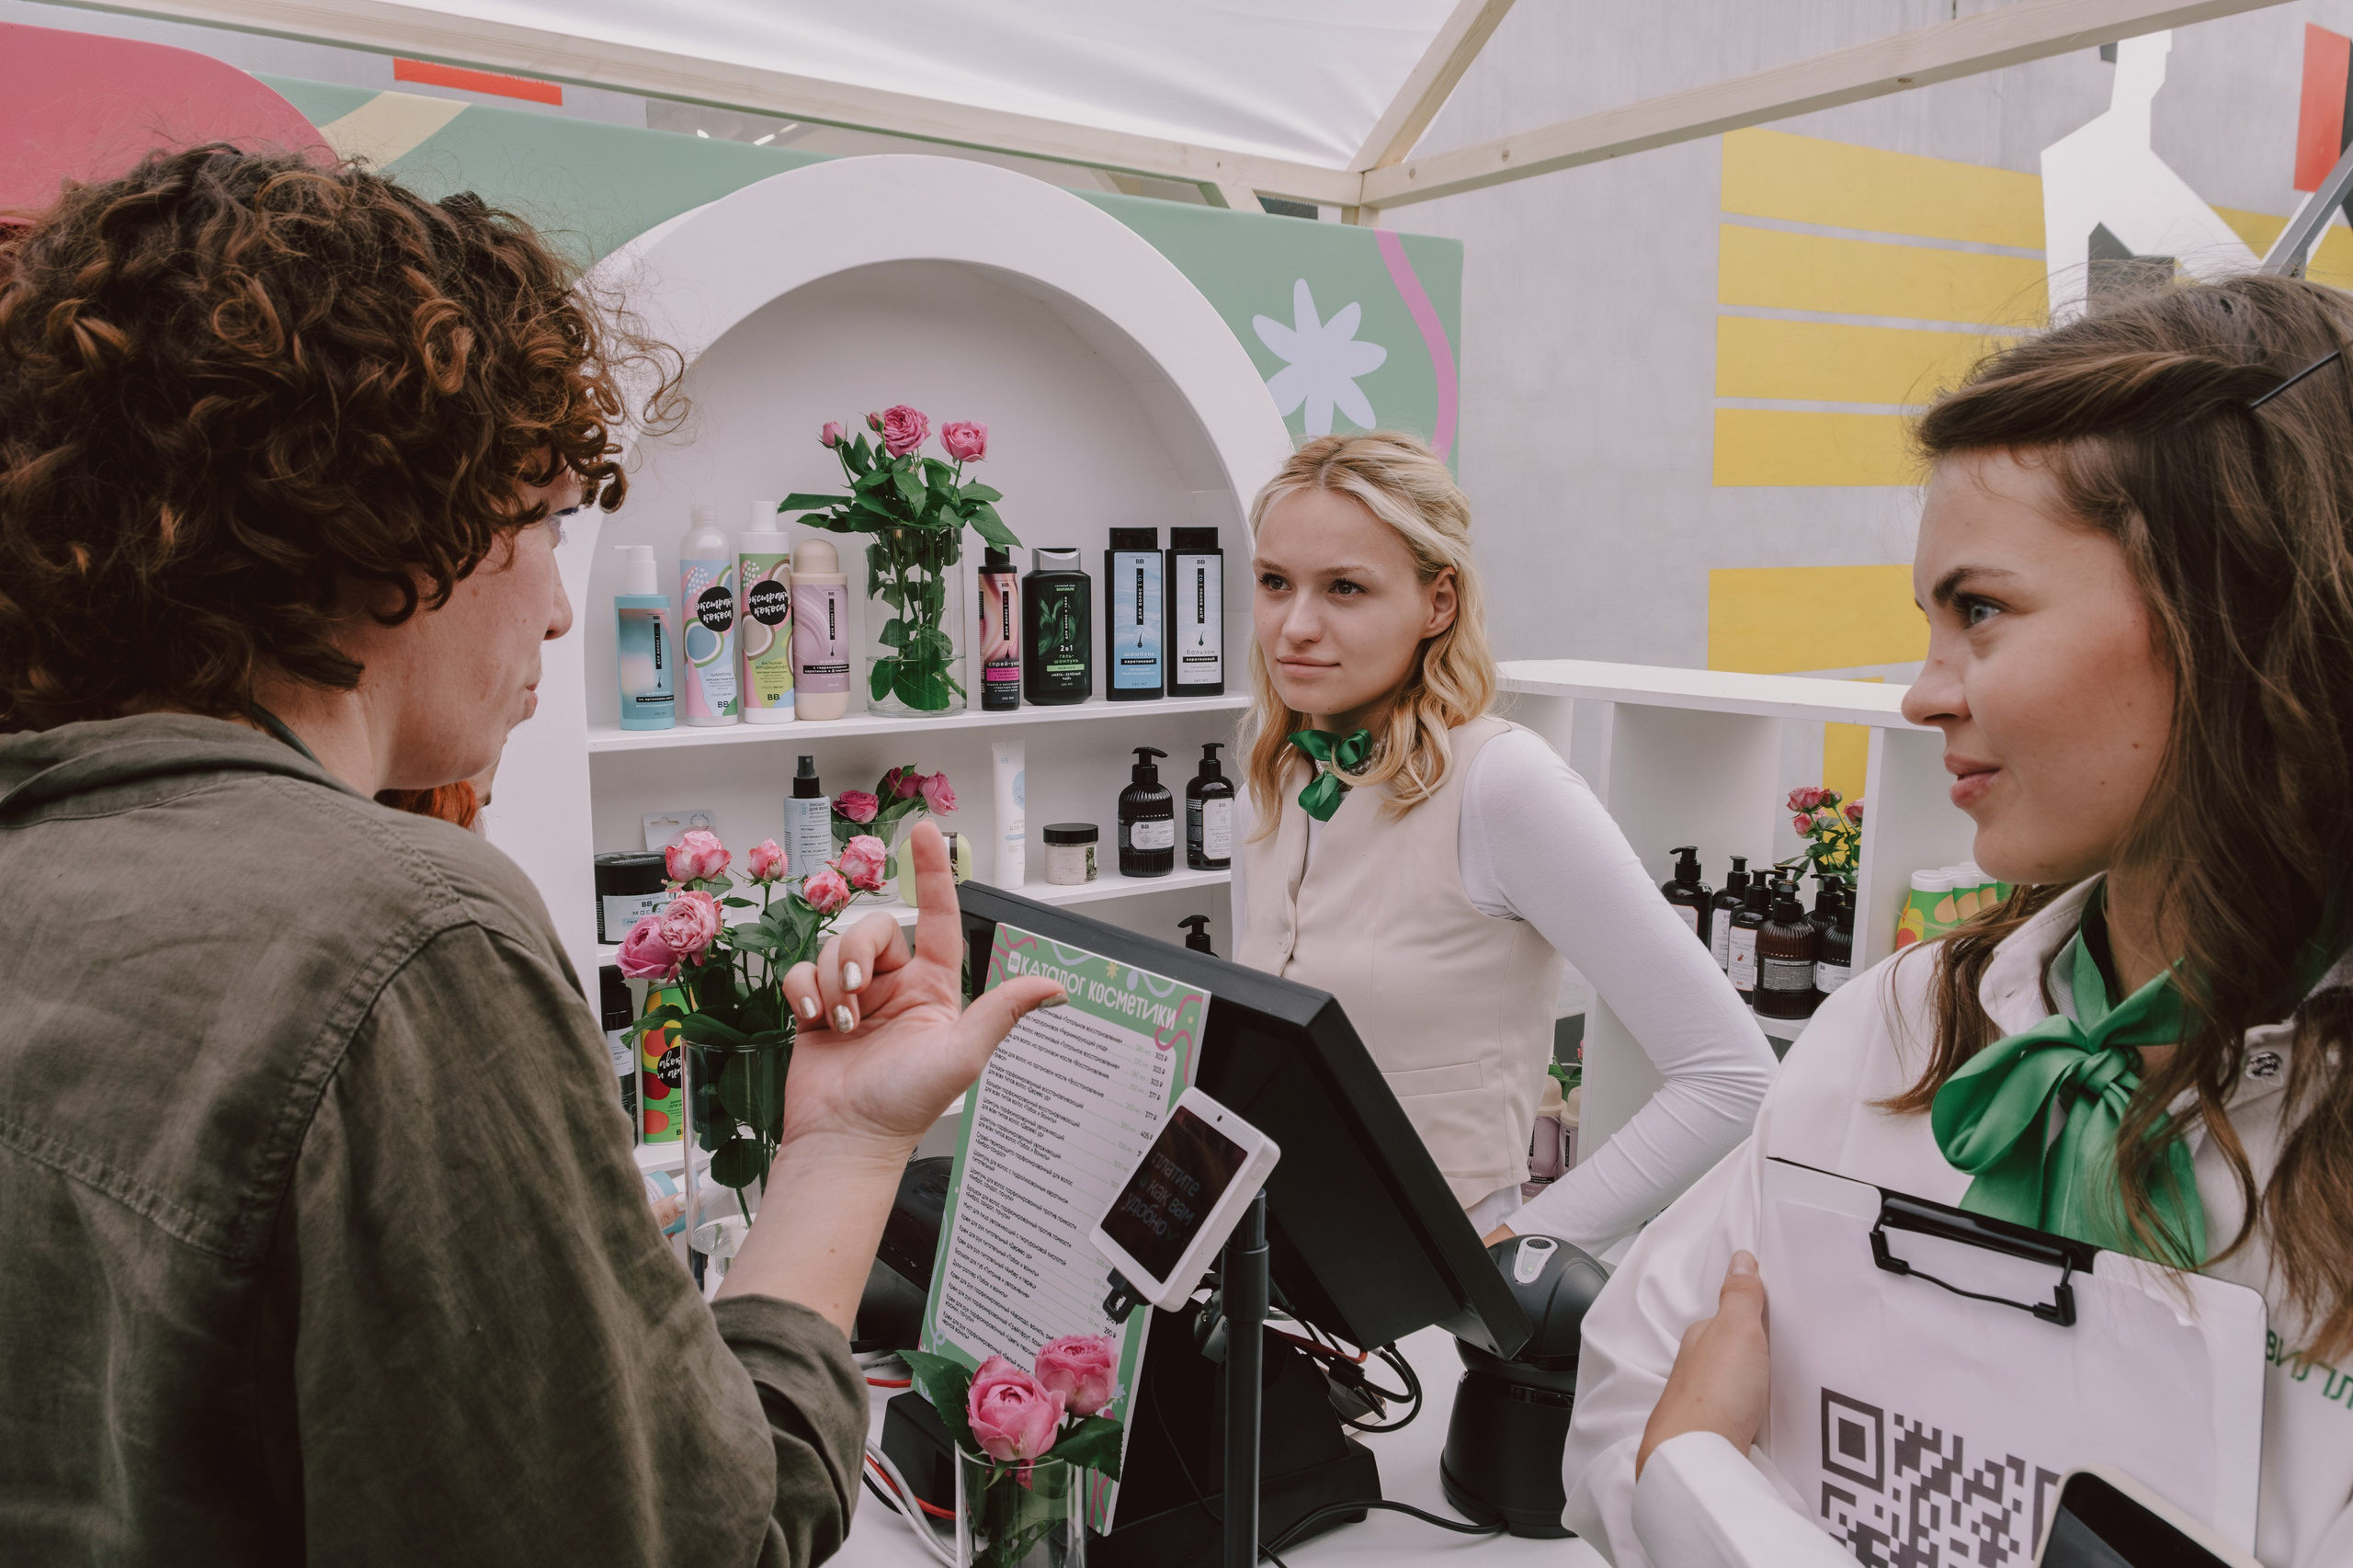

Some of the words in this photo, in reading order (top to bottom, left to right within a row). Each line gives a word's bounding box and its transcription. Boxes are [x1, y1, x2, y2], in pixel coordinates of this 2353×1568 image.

[703, 609, 733, 624] кокоса
[754, 603, 786, 618] кокоса
[1087, 980, 1176, 1030] КОСМЕТИКИ
[1154, 1051, 1164, 1061] 303
[1150, 1076, 1158, 1086] 303
[1140, 1129, 1149, 1140] 405
[1146, 1179, 1172, 1207] как
[1167, 1197, 1196, 1226] вам
[1121, 1192, 1167, 1235] удобно
[1104, 1326, 1112, 1337] 290
